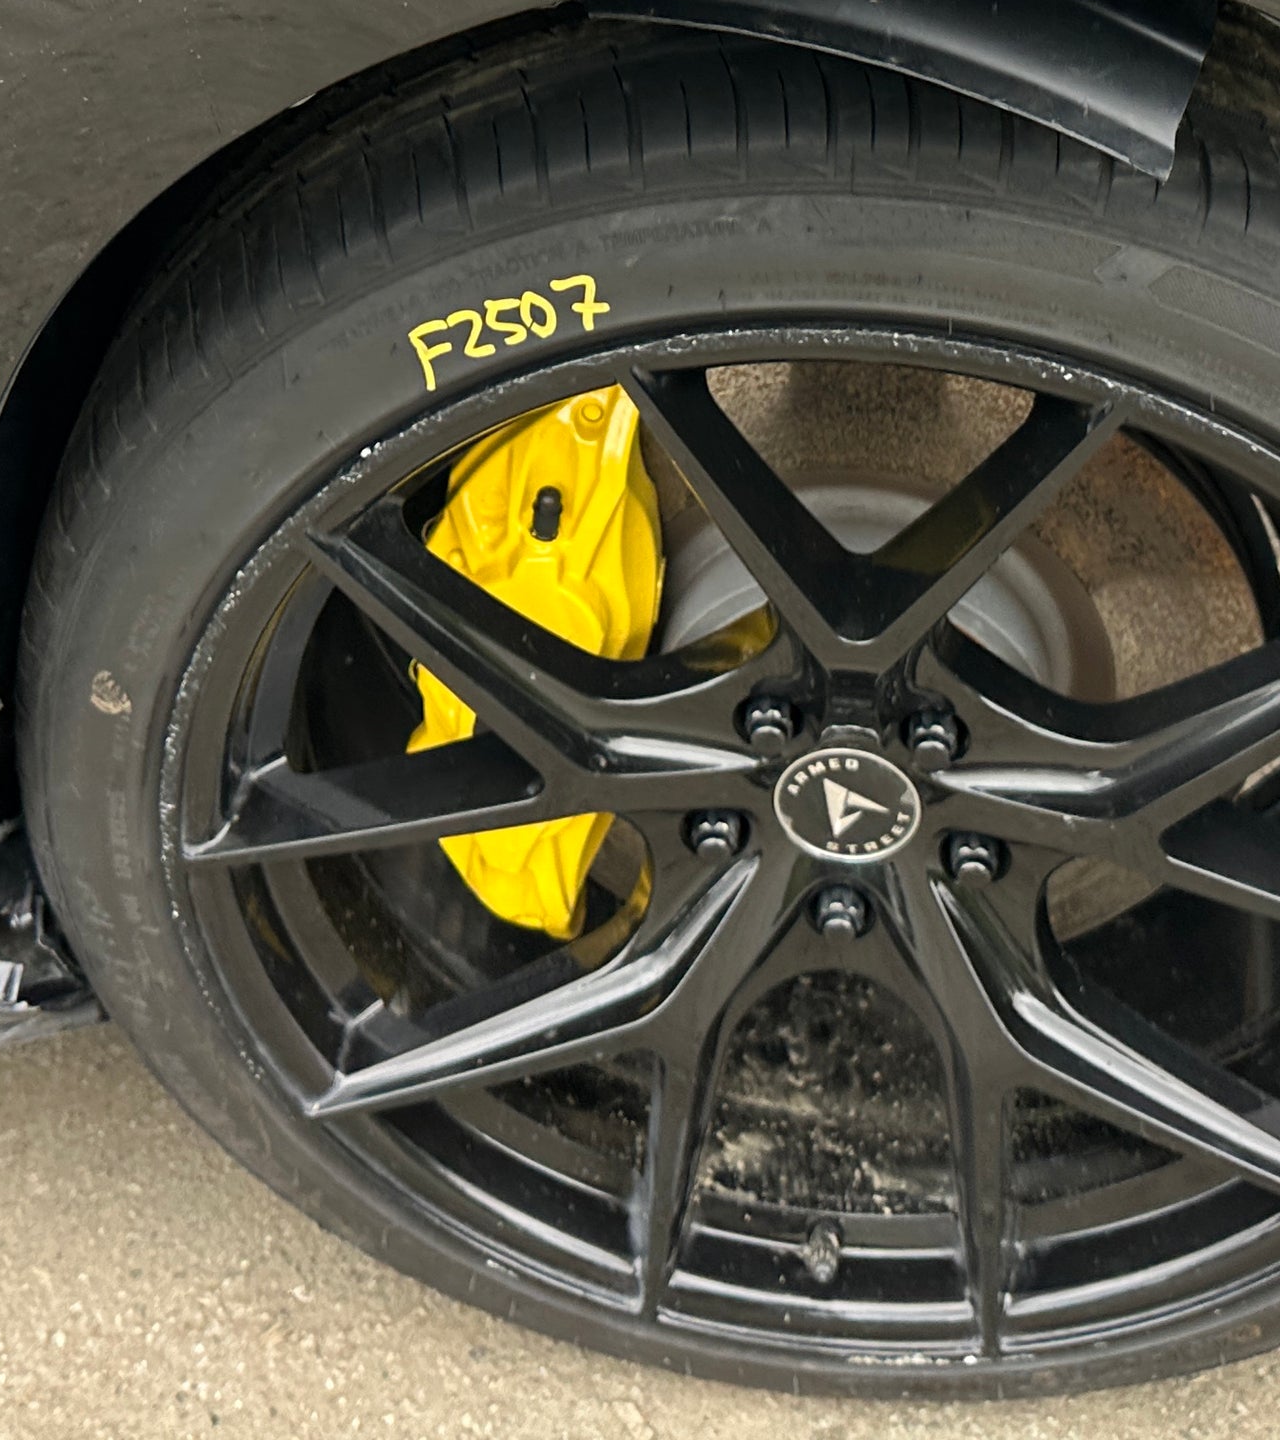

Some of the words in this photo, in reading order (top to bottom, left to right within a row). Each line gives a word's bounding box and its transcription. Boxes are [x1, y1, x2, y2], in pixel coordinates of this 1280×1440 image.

[407, 274, 611, 392] F2507
[786, 757, 859, 796] ARMED
[826, 811, 910, 855] STREET
